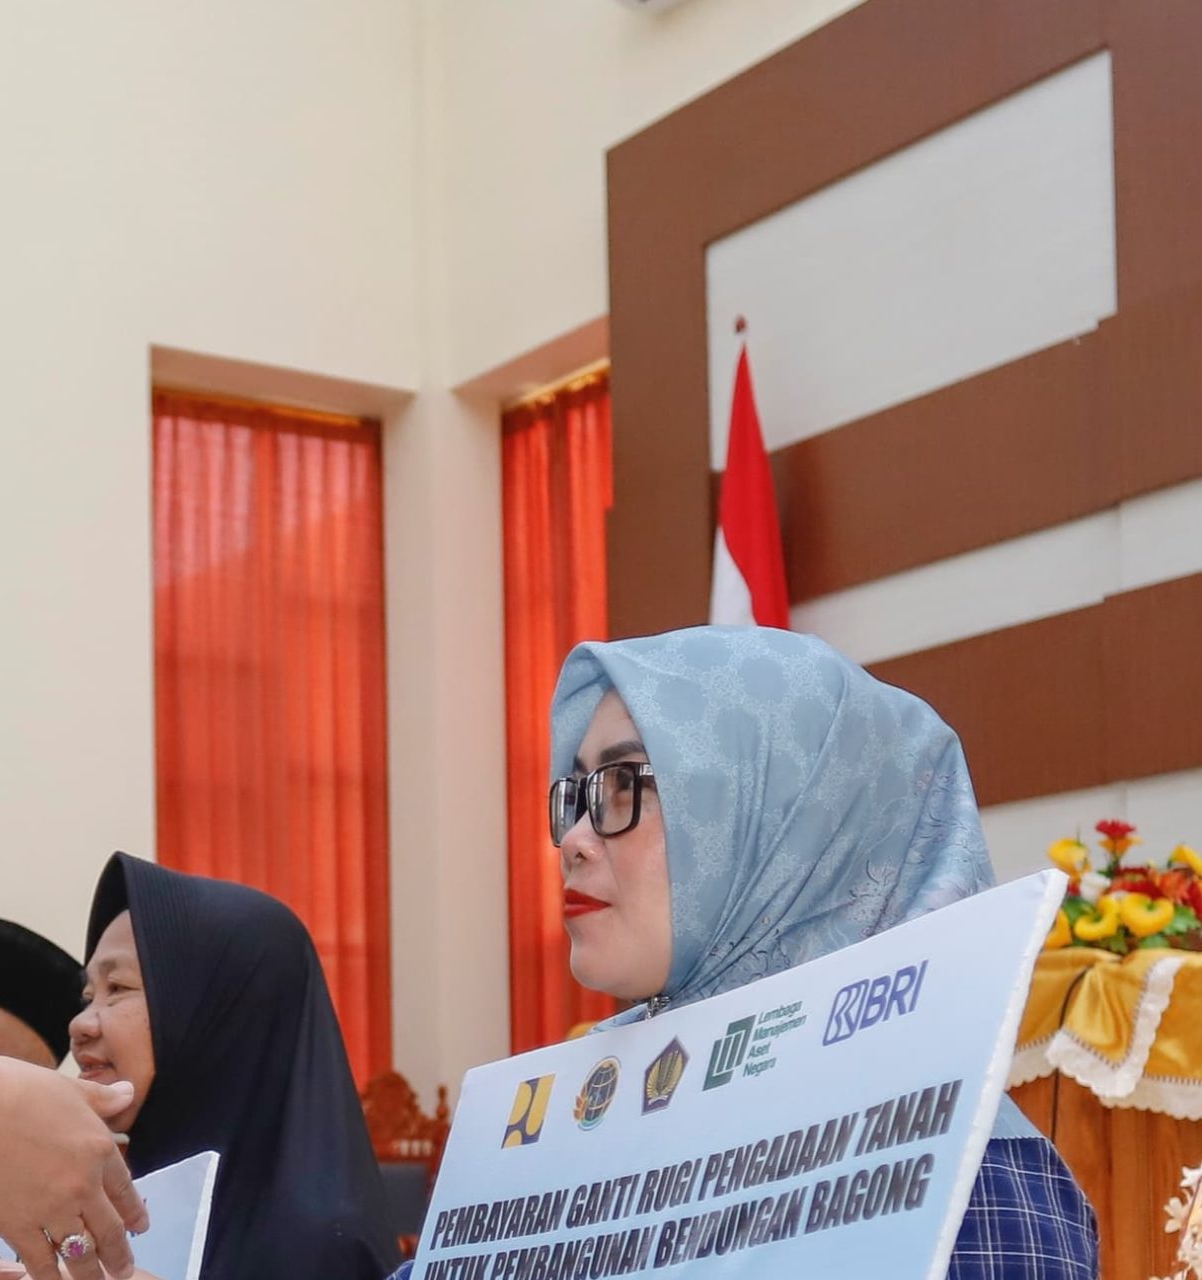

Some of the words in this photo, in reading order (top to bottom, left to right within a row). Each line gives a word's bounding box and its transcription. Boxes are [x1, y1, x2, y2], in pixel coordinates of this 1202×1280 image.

[858, 960, 930, 1031] BRI
[742, 1057, 777, 1078] Negara
[429, 1188, 569, 1251] PEMBAYARAN
[565, 1173, 641, 1230] GANTI
[635, 1157, 703, 1216] RUGI
[697, 1111, 860, 1202] PENGADAAN
[854, 1079, 964, 1157] TANAH
[653, 1186, 809, 1269] BENDUNGAN
[804, 1153, 936, 1235] BAGONG
